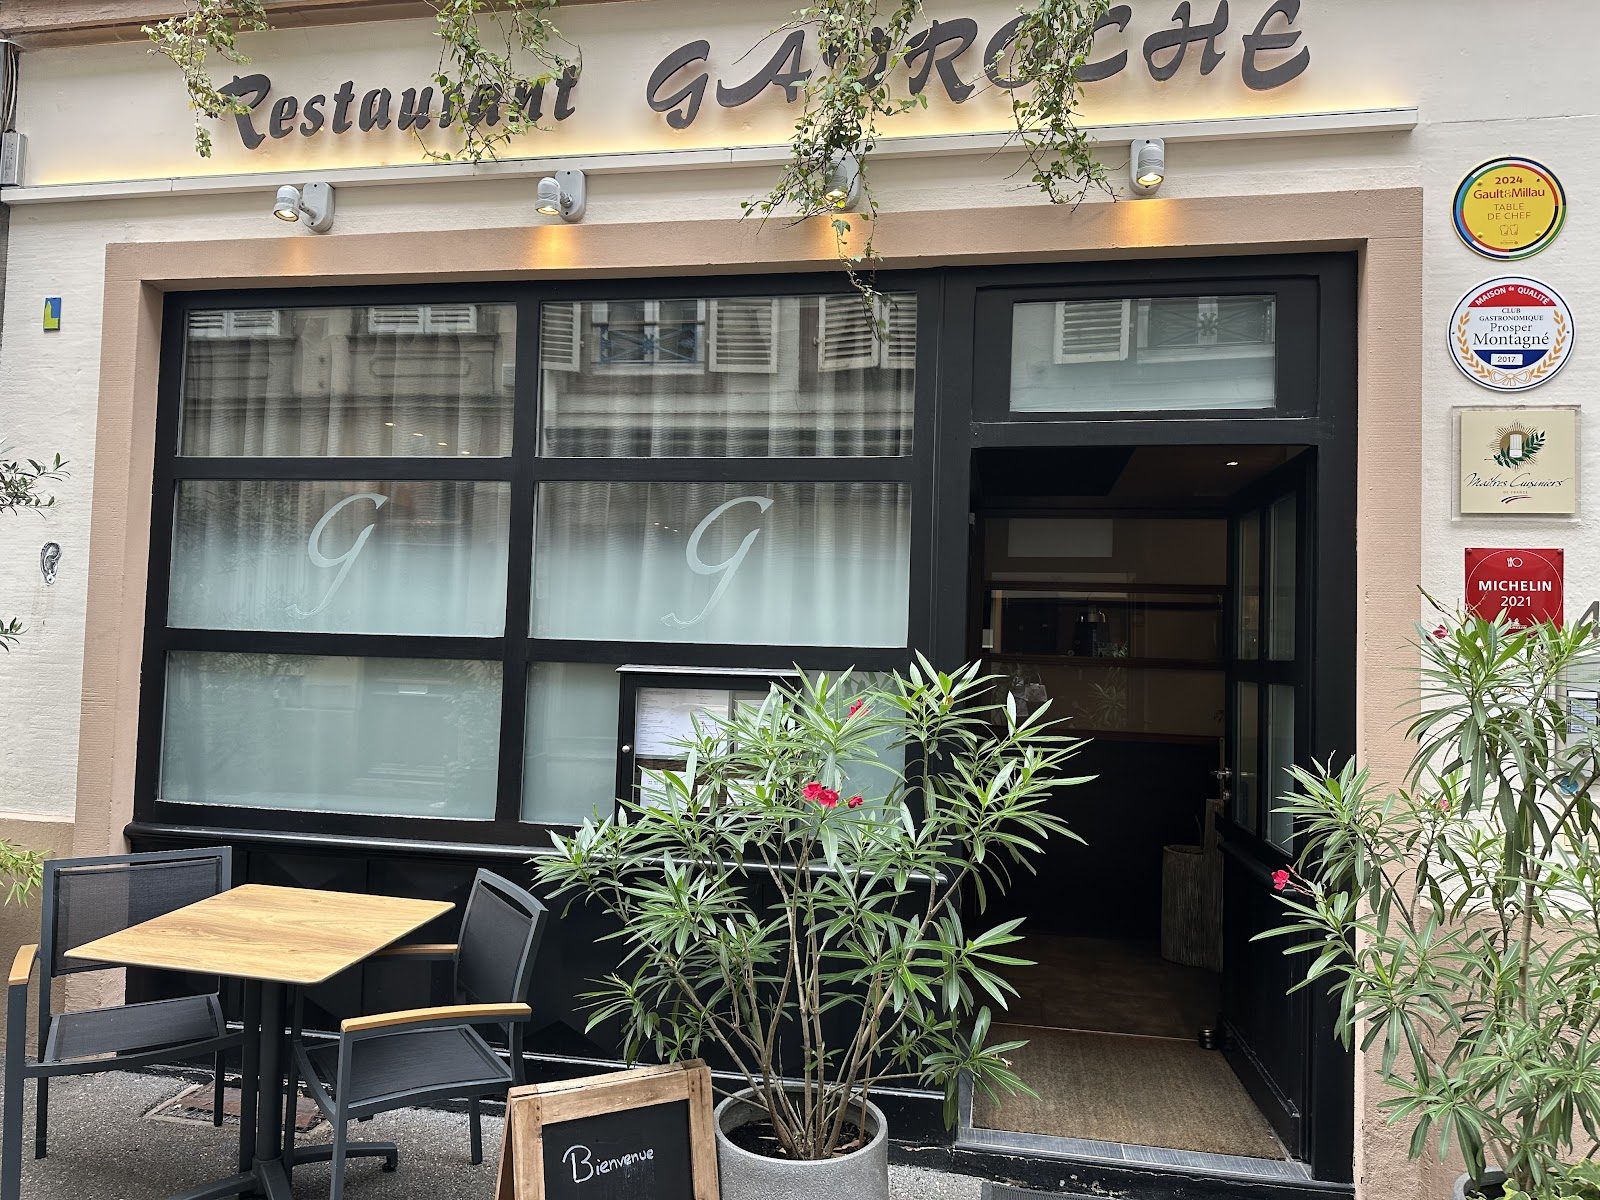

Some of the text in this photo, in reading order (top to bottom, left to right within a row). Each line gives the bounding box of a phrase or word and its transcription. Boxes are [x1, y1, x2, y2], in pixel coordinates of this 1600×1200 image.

[212, 64, 578, 150] Restaurant
[1495, 176, 1523, 185] 2024
[1494, 203, 1525, 211] TABLE
[1487, 212, 1531, 221] DE CHEF
[1474, 287, 1506, 306] MAISON
[1517, 286, 1551, 305] QUALITÉ
[1490, 322, 1532, 334] Prosper
[1473, 332, 1549, 349] Montagné
[1478, 580, 1552, 591] MICHELIN
[1500, 595, 1532, 607] 2021
[561, 1144, 655, 1184] Bienvenue
